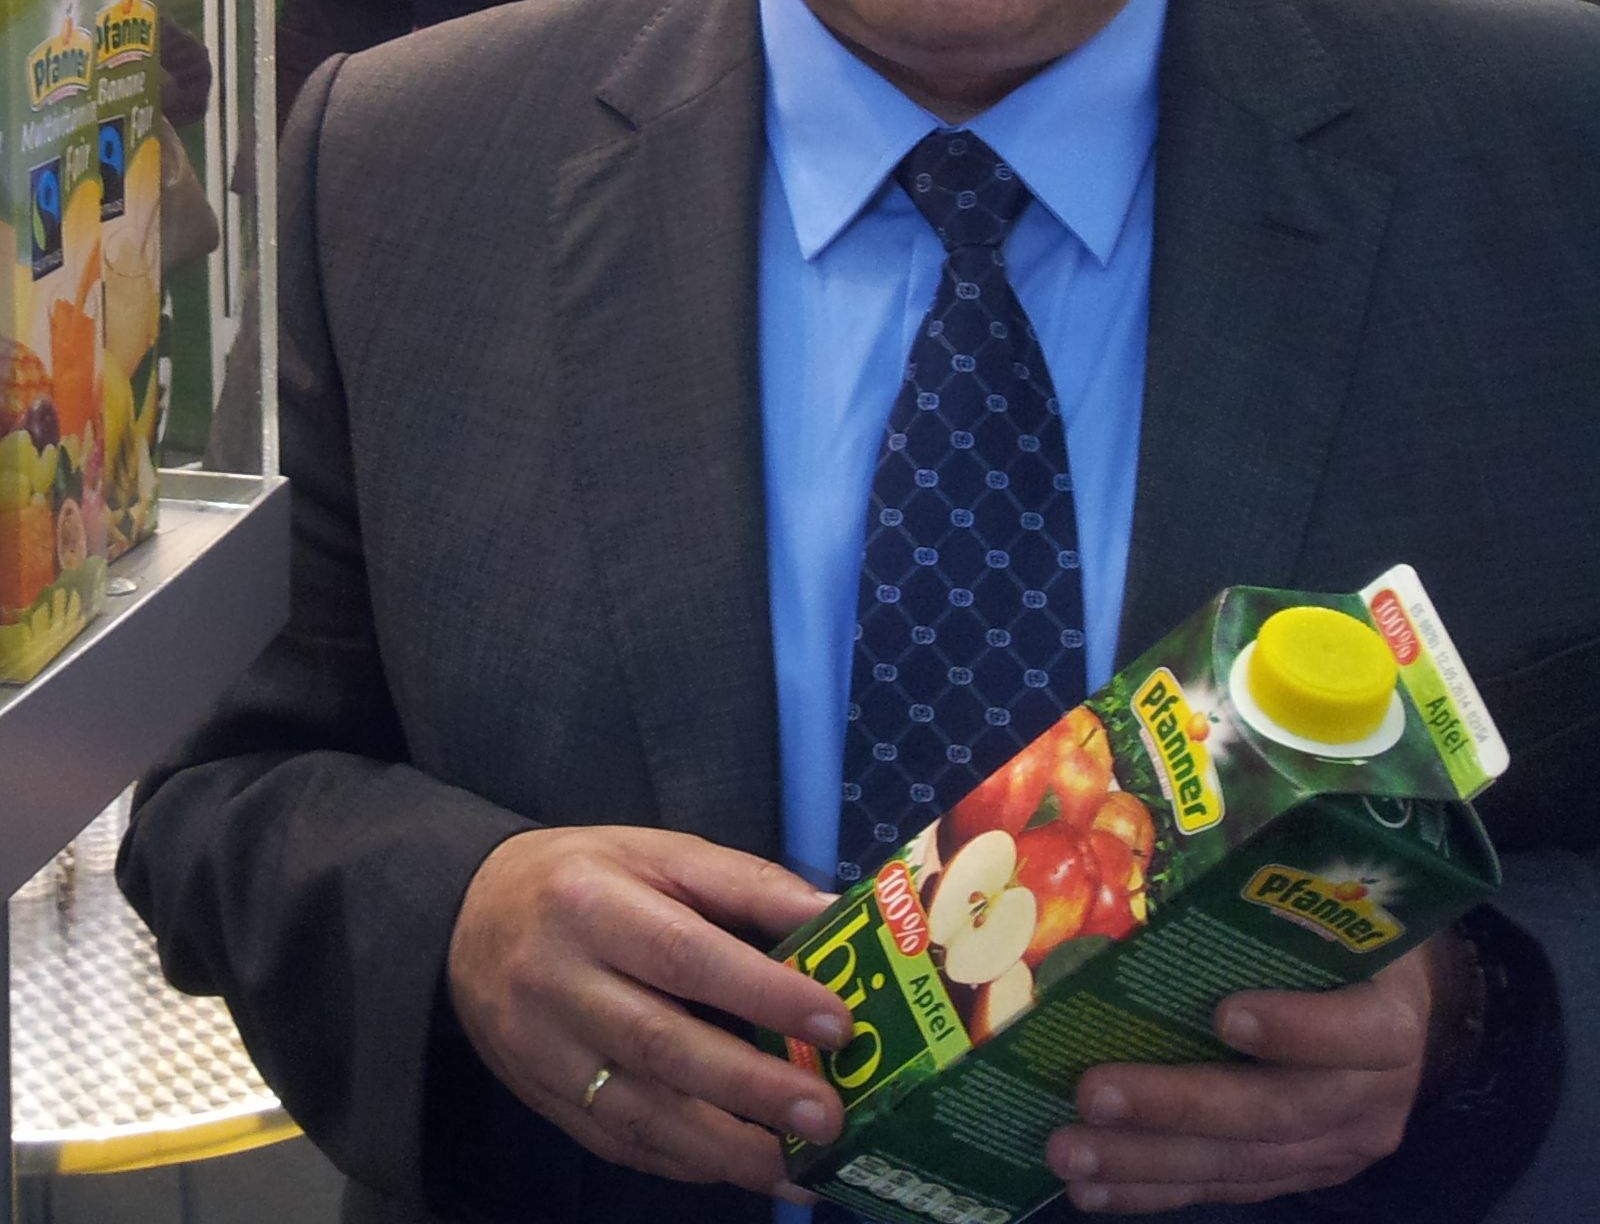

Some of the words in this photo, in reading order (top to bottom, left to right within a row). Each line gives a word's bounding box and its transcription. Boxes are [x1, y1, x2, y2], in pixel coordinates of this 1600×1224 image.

[1376, 597, 1414, 659] 100%
[1426, 695, 1470, 755] Apfel
[877, 867, 923, 954] 100%
[805, 901, 886, 1089] bio
[909, 973, 957, 1043] Apfel
